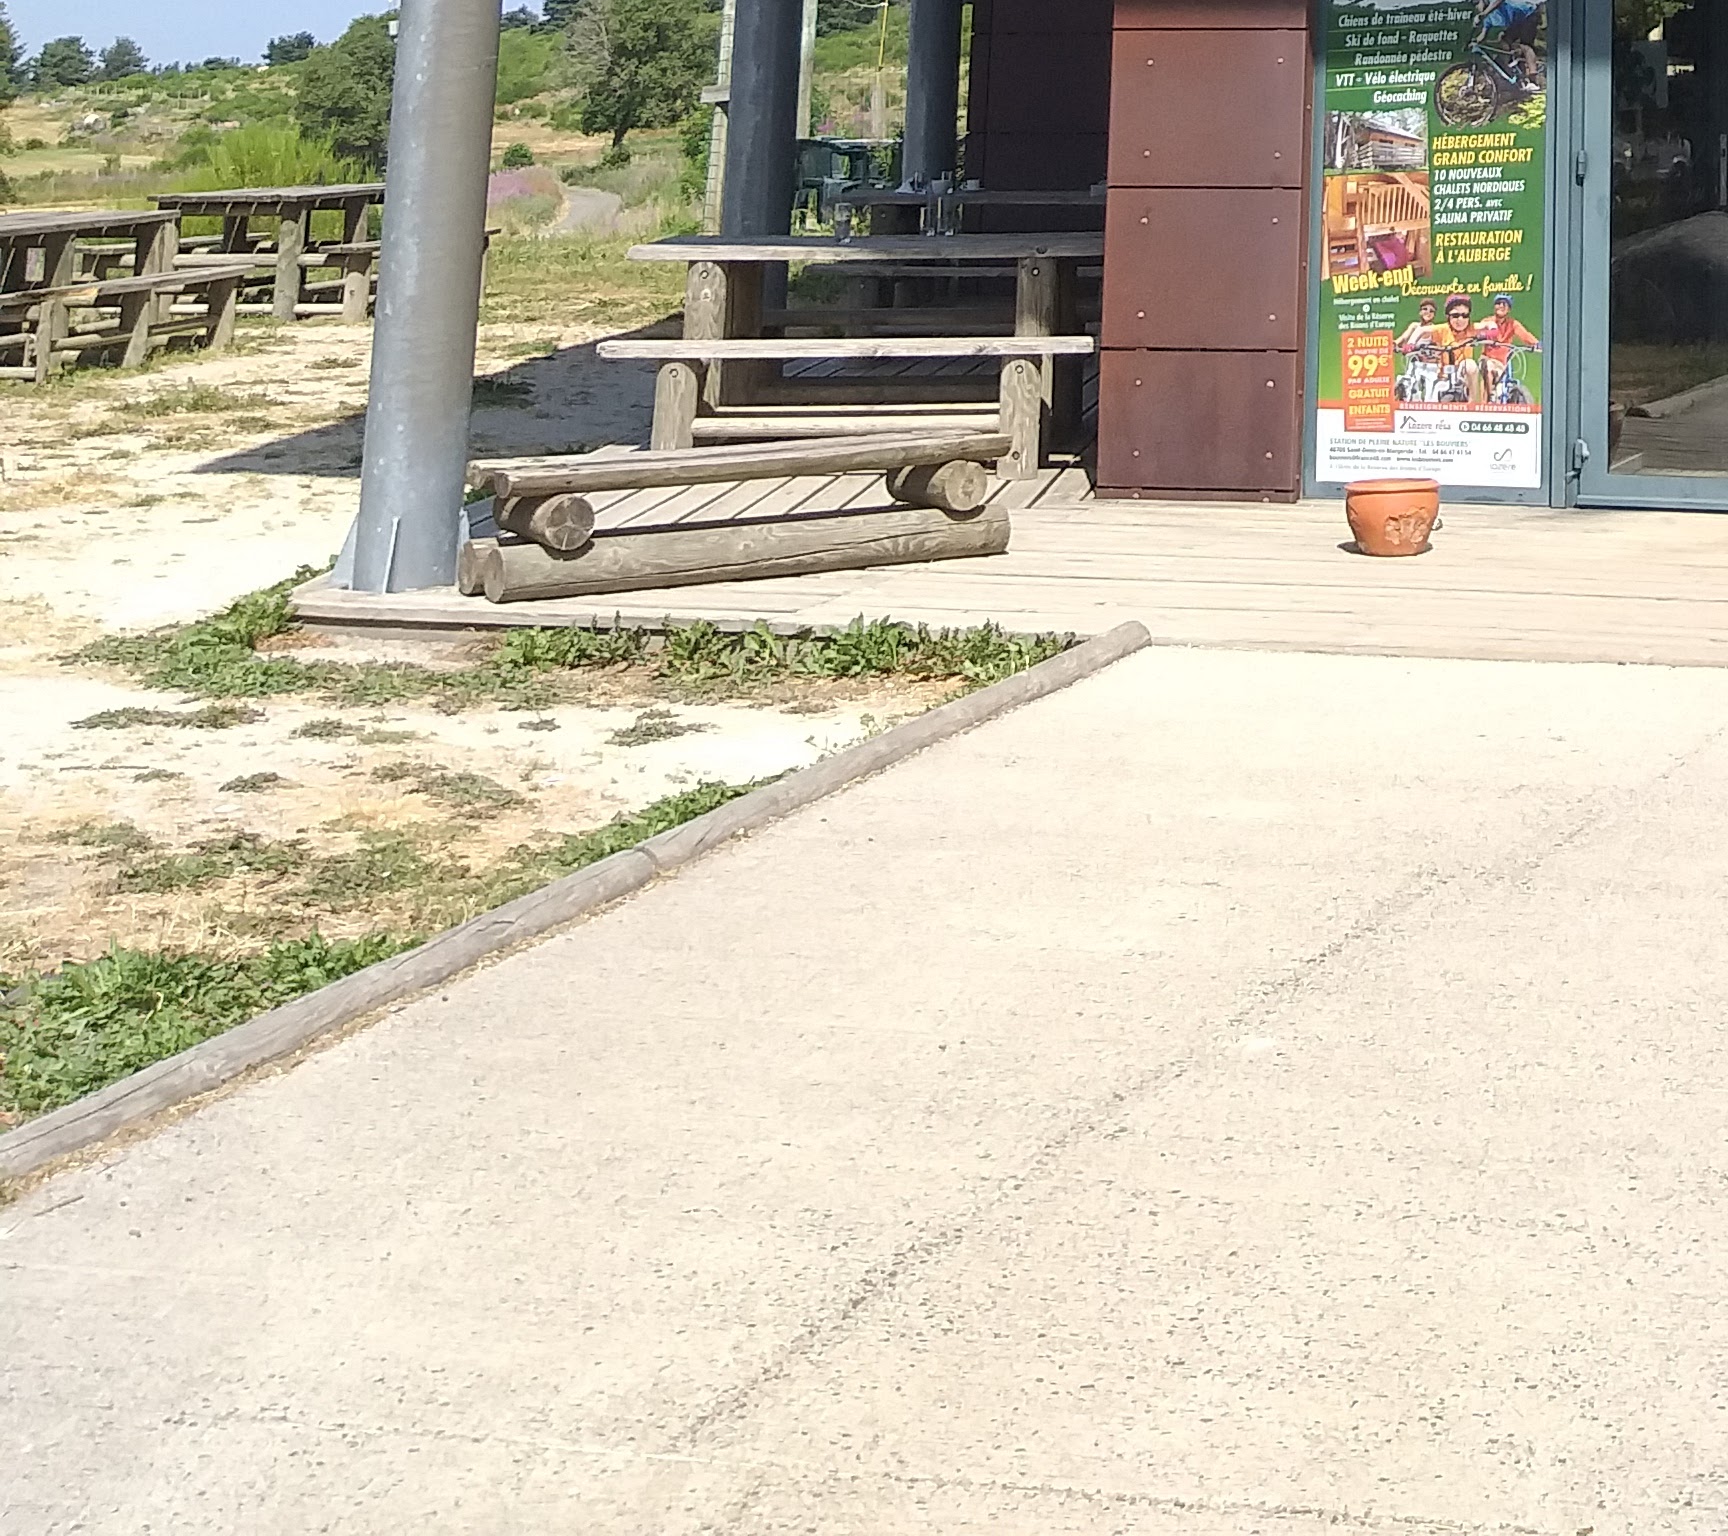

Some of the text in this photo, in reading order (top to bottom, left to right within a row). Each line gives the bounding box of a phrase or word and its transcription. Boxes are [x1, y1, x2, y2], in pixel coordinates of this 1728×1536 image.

[1339, 15, 1369, 27] Chiens
[1372, 13, 1384, 25] de
[1428, 8, 1473, 22] été-hiver
[1346, 35, 1360, 47] Ski
[1363, 34, 1374, 45] de
[1377, 31, 1399, 45] fond
[1409, 30, 1458, 44] Raquettes
[1355, 50, 1452, 66] Randonnée pédestre
[1336, 74, 1354, 87] VTT
[1364, 72, 1386, 84] Vélo
[1389, 70, 1435, 84] électrique
[1373, 89, 1427, 104] Géocaching
[1432, 132, 1516, 149] HÉBERGEMENT
[1433, 148, 1533, 165] GRAND CONFORT
[1434, 167, 1502, 180] 10 NOUVEAUX
[1434, 180, 1525, 194] CHALETS NORDIQUES
[1435, 196, 1502, 210] 2/4 PERS. AVEC
[1435, 210, 1513, 224] SAUNA PRIVATIF
[1436, 230, 1523, 246] RESTAURATION
[1436, 247, 1511, 263] À L'AUBERGE
[1333, 265, 1414, 294] Week-end
[1402, 274, 1533, 296] Découverte en famille !
[1347, 336, 1389, 348] 2 NUITS
[1348, 388, 1389, 399] GRATUIT
[1349, 404, 1390, 415] ENFANTS
[1399, 403, 1468, 411] RENSEIGNEMENTS
[1471, 423, 1481, 431] 04
[1493, 424, 1503, 432] 48
[1504, 424, 1514, 432] 48
